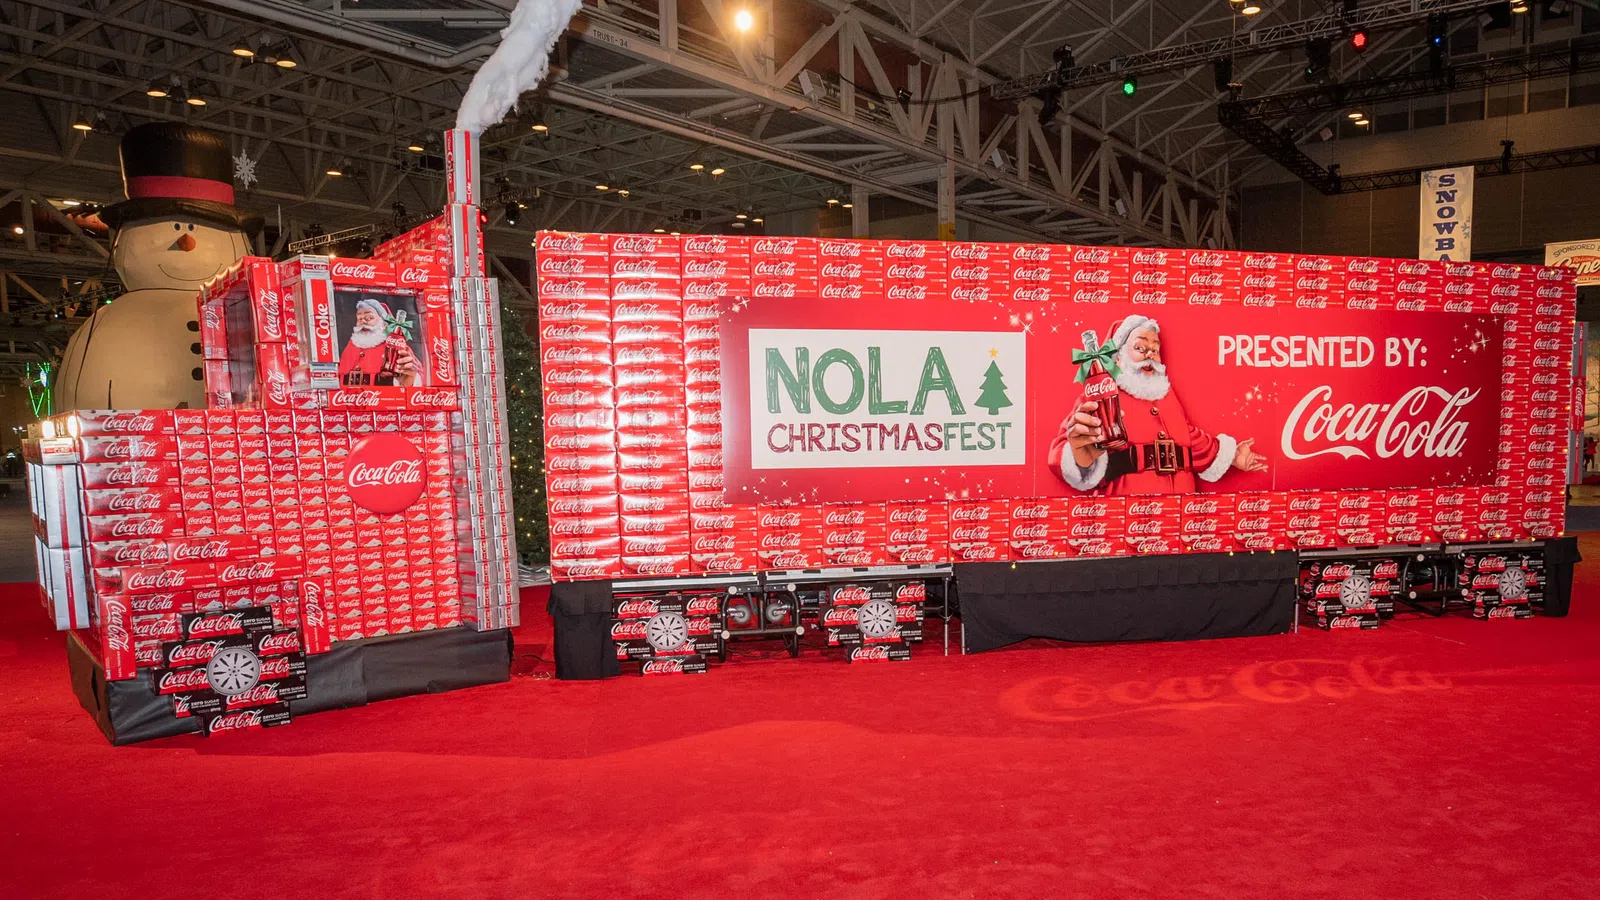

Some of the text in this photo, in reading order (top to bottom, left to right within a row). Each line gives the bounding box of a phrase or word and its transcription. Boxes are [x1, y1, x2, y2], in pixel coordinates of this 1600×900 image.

[540, 235, 585, 251] Coca-Cola
[613, 237, 658, 253] Coca-Cola
[685, 238, 728, 253] Coca-Cola
[754, 240, 796, 255] Coca-Cola
[821, 242, 862, 256] Coca-Cola
[887, 244, 927, 258] Coca-Cola
[951, 245, 990, 259] Coca-Cola
[1013, 246, 1051, 261] Coca-Cola
[1074, 249, 1111, 263] Coca-Cola
[1553, 244, 1596, 258] SPONSORED
[413, 255, 435, 263] Coca-Cola
[541, 257, 586, 273] Coca-Cola
[1132, 252, 1168, 265] Coca-Cola
[1189, 252, 1224, 266] Coca-Cola
[1244, 255, 1277, 269] Coca-Cola
[1297, 258, 1330, 271] Coca-Cola
[332, 262, 377, 279] Coca-Cola
[614, 259, 658, 275] Coca-Cola
[685, 260, 728, 276] Coca-Cola
[755, 261, 796, 276] Coca-Cola
[822, 263, 862, 277] Coca-Cola
[887, 264, 927, 278] Coca-Cola
[951, 266, 990, 280] Coca-Cola
[1348, 259, 1380, 273] Coca-Cola
[1398, 261, 1430, 275] Coca-Cola
[1446, 264, 1476, 277] Coca-Cola
[1492, 266, 1521, 279] Coca-Cola
[1013, 267, 1052, 281] Coca-Cola
[1074, 269, 1111, 283] Coca-Cola
[1133, 271, 1168, 285] Coca-Cola
[1189, 272, 1224, 286] Coca-Cola
[1244, 274, 1277, 288] Coca-Cola
[1537, 268, 1563, 281] Coca-Cola
[541, 279, 586, 295] Coca-Cola
[614, 281, 659, 296] Coca-Cola
[686, 281, 729, 296] Coca-Cola
[755, 283, 796, 298] Coca-Cola
[822, 284, 862, 298] Coca-Cola
[888, 285, 927, 299] Coca-Cola
[951, 287, 990, 300] Coca-Cola
[1013, 287, 1051, 301] Coca-Cola
[1074, 289, 1111, 303] Coca-Cola
[1133, 291, 1168, 304] Coca-Cola
[1189, 292, 1223, 305] Coca-Cola
[1243, 294, 1277, 307] Coca-Cola
[1296, 295, 1329, 309] Coca-Cola
[1347, 297, 1379, 310] Coca-Cola
[1396, 298, 1427, 311] Coca-Cola
[1444, 300, 1474, 313] Coca-Cola
[1491, 301, 1519, 314] Coca-Cola
[1536, 303, 1563, 316] Coca-Cola
[260, 288, 282, 339] Coca-Cola
[315, 303, 330, 339] Coke
[1218, 335, 1427, 368] PRESENTED BY:
[434, 336, 452, 382] Coca-Cola
[268, 369, 288, 405] Coca-Cola
[765, 346, 967, 415] NOLA
[1084, 377, 1117, 397] Coca-Cola
[332, 390, 381, 407] Coca-Cola
[411, 391, 457, 407] Coca-Cola
[102, 415, 156, 431] Coca-Cola
[1281, 385, 1481, 460] Coca-Cola
[767, 422, 1012, 453] CHRISTMASFEST
[105, 442, 158, 458] Coca-Cola
[107, 468, 161, 484] Coca-Cola
[348, 459, 424, 488] Coca-Cola
[109, 493, 162, 510] Coca-Cola
[1340, 496, 1370, 509] Coca-Cola
[1389, 495, 1419, 508] Coca-Cola
[1436, 493, 1465, 506] Coca-Cola
[1481, 493, 1510, 505] Coca-Cola
[1525, 491, 1552, 503] Coca-Cola
[1071, 504, 1108, 518] Coca-Cola
[1128, 501, 1164, 516] Coca-Cola
[1184, 500, 1218, 515] Coca-Cola
[1238, 498, 1271, 513] Coca-Cola
[1290, 498, 1321, 511] Coca-Cola
[826, 510, 866, 525] Coca-Cola
[890, 508, 929, 523] Coca-Cola
[952, 506, 991, 520] Coca-Cola
[1013, 505, 1050, 519] Coca-Cola
[553, 519, 595, 535] Coca-Cola
[624, 517, 666, 533] Coca-Cola
[694, 514, 736, 530] Coca-Cola
[761, 513, 802, 527] Coca-Cola
[1128, 520, 1164, 534] Coca-Cola
[1184, 518, 1218, 533] Coca-Cola
[1238, 517, 1271, 531] Coca-Cola
[112, 519, 165, 537] Coca-Cola
[890, 528, 929, 542] Coca-Cola
[952, 526, 991, 540] Coca-Cola
[1013, 523, 1050, 538] Coca-Cola
[1071, 523, 1107, 537] Coca-Cola
[695, 534, 736, 551] Coca-Cola
[761, 533, 802, 547] Coca-Cola
[826, 530, 867, 545] Coca-Cola
[173, 540, 230, 560] Coca-Cola
[554, 540, 596, 556] Coca-Cola
[625, 537, 667, 553] Coca-Cola
[115, 545, 168, 562] Coca-Cola
[1479, 557, 1508, 569] Coca-Cola
[222, 561, 276, 583] Coca-Cola
[1322, 564, 1356, 577] Coca-Cola
[128, 569, 187, 590] Coca-Cola
[833, 587, 873, 602] Coca-Cola
[304, 581, 324, 628] Coca-Cola
[618, 600, 661, 614] Coca-Cola
[1488, 606, 1517, 618] Coca-Cola
[106, 600, 129, 652] Coca-Cola
[188, 612, 245, 634] Coca-Cola
[1330, 616, 1363, 629] Coca-Cola
[851, 645, 891, 660] Coca-Cola
[643, 659, 685, 674] Coca-Cola
[209, 709, 264, 732] Coca-Cola
